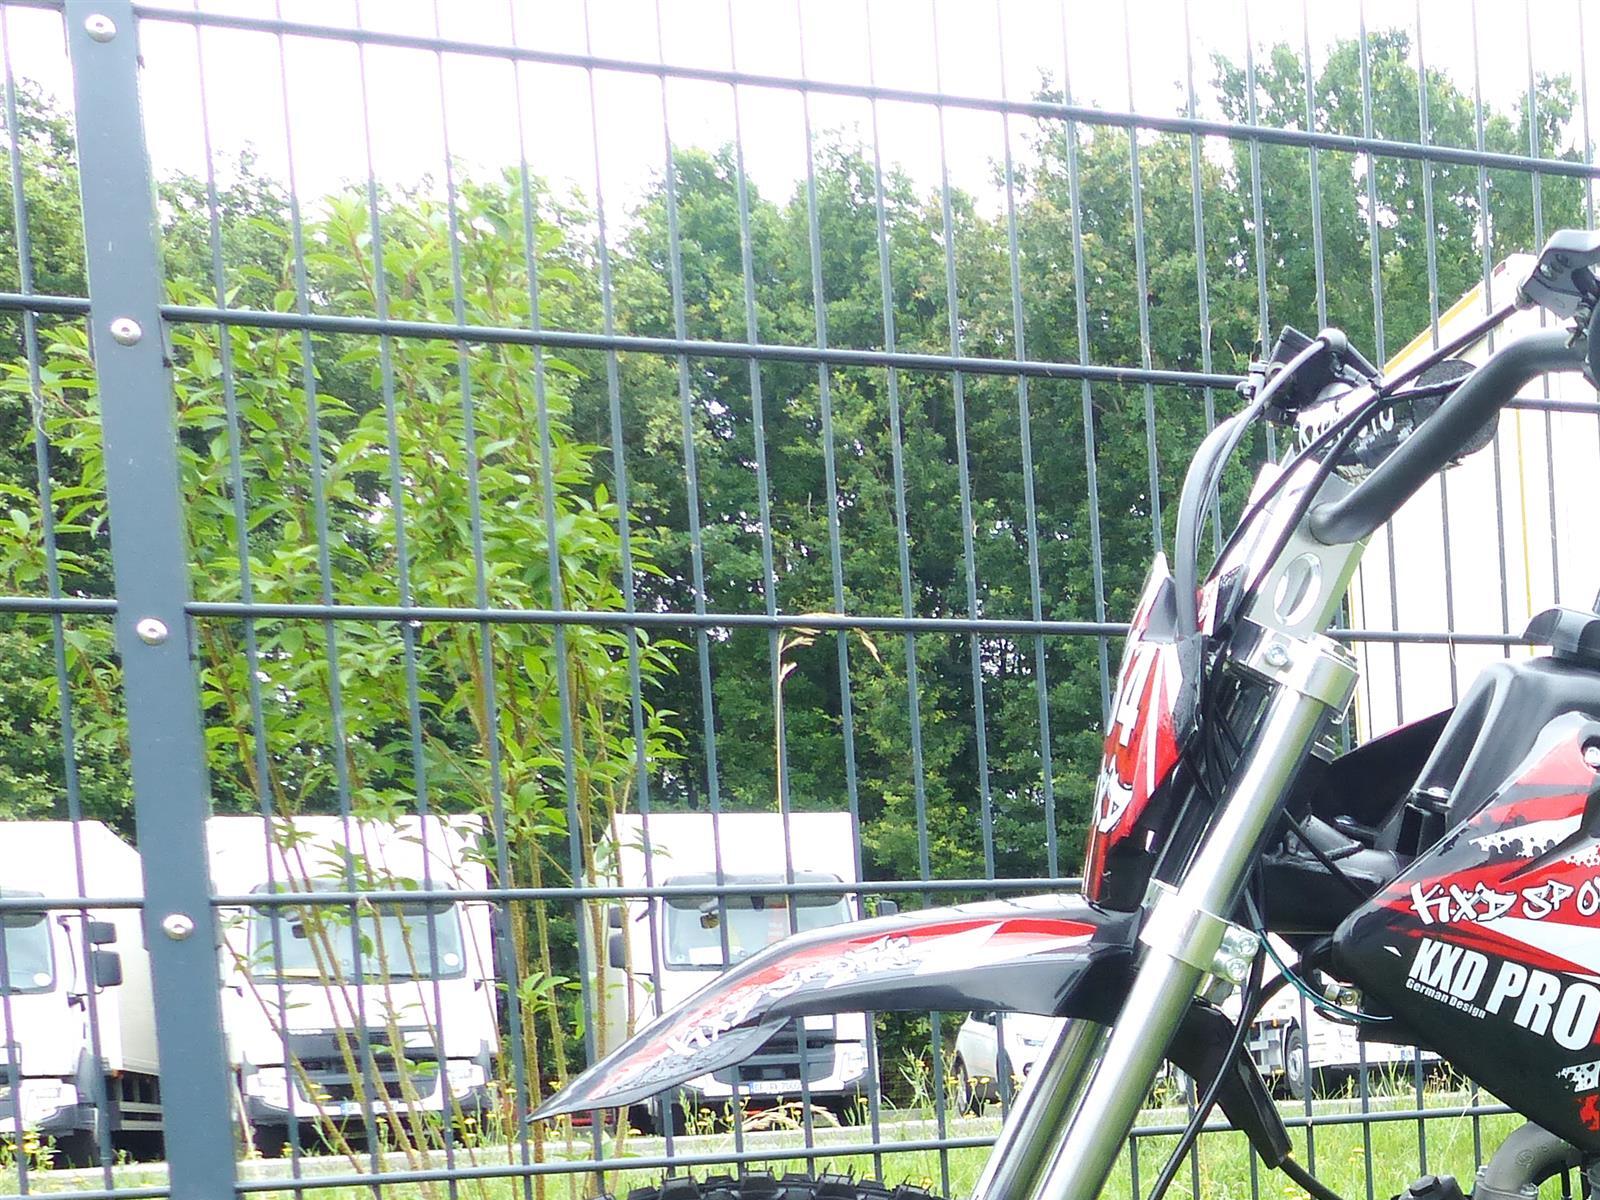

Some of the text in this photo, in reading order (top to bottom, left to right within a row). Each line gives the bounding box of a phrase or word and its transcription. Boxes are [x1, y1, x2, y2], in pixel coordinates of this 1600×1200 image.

[1410, 881, 1518, 925] KXD
[1408, 938, 1489, 1002] KXD
[1405, 978, 1486, 1019] German Design
